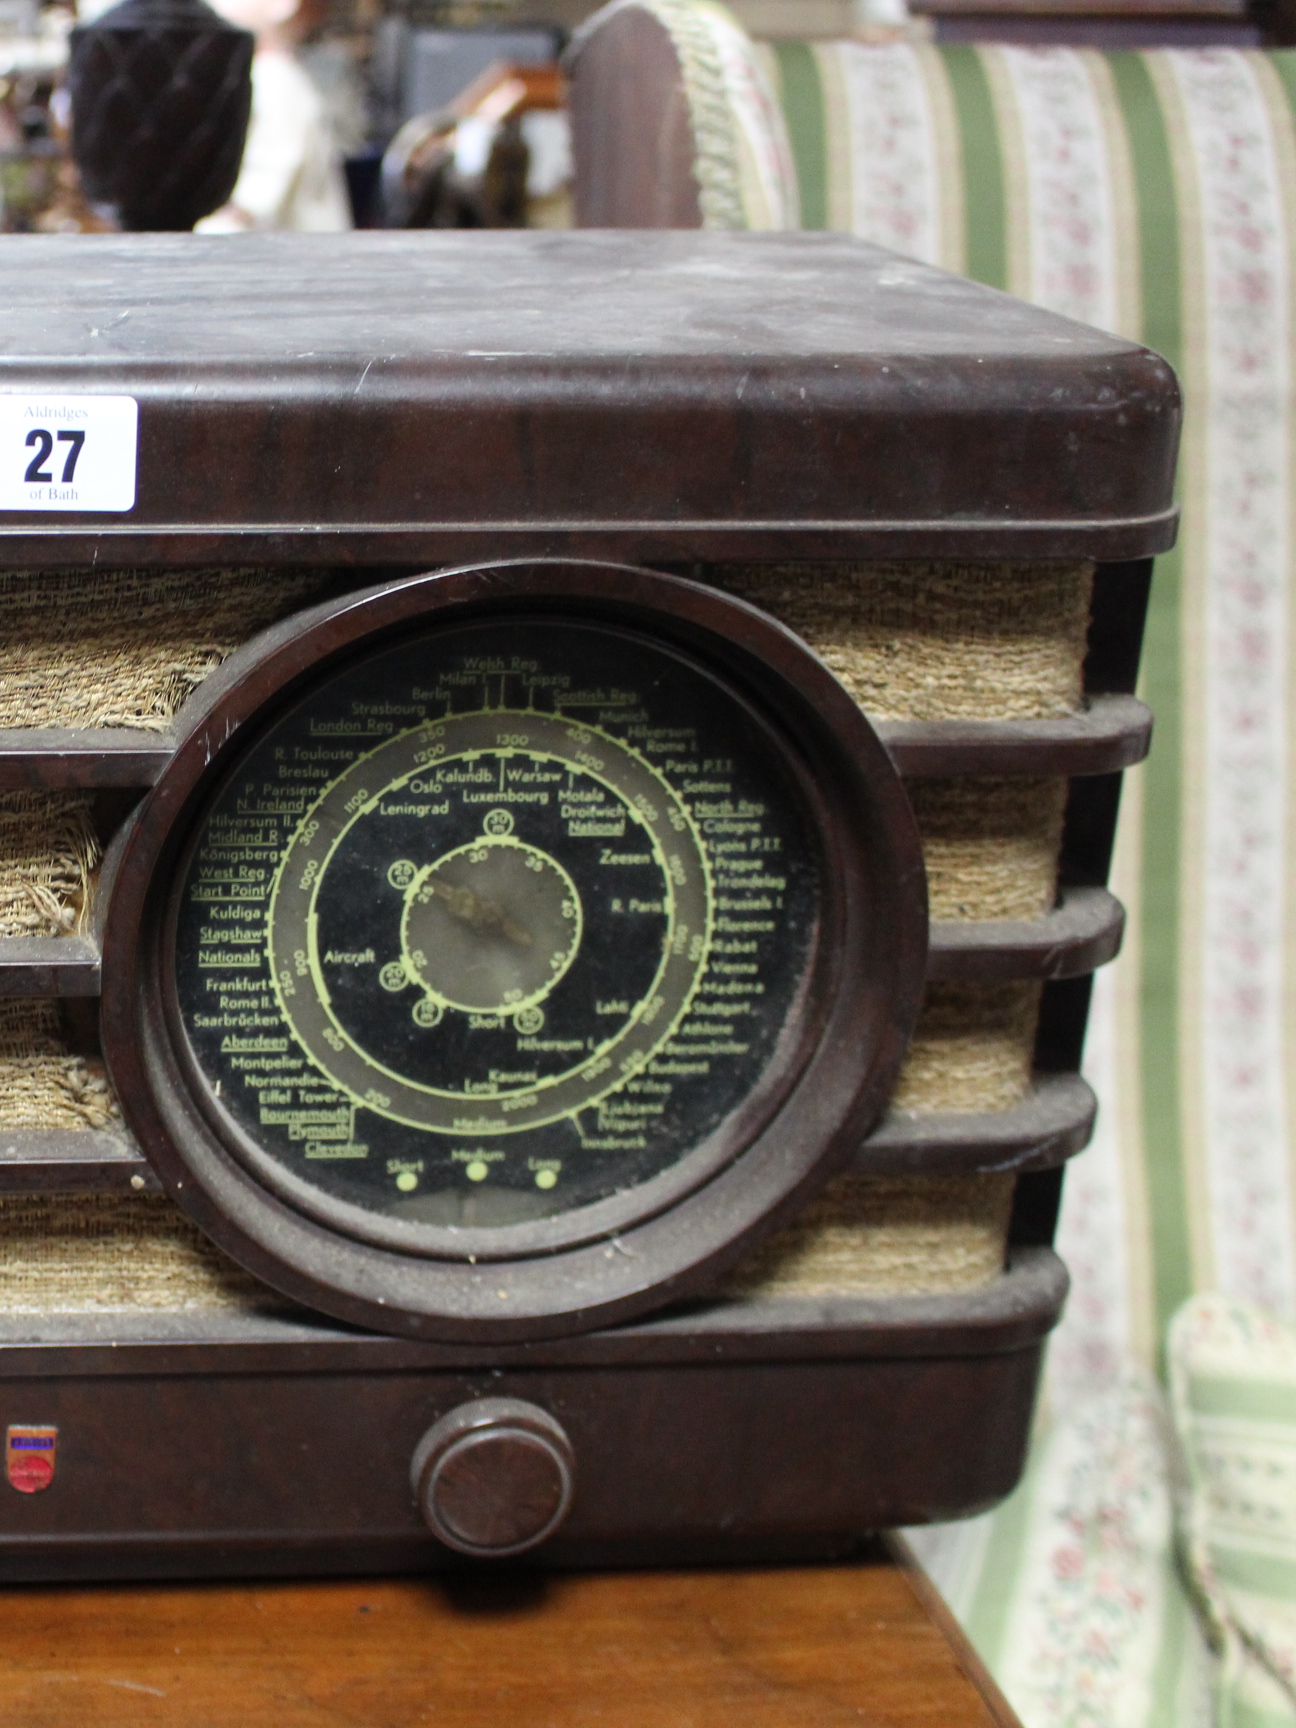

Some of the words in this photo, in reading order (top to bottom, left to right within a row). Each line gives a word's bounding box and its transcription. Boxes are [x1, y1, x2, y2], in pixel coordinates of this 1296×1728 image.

[24, 406, 88, 421] Aldridges
[24, 429, 85, 483] 27
[30, 488, 44, 500] of
[48, 488, 78, 500] Bath
[464, 656, 504, 669] Welsh
[439, 673, 476, 686] Milan
[522, 673, 571, 689] Leipzig
[412, 687, 451, 700] Berlin
[352, 701, 426, 717] Strasbourg
[310, 718, 361, 732] London
[418, 726, 446, 743] 350
[496, 733, 529, 746] 1300
[565, 727, 592, 744] 400
[275, 748, 287, 760] R.
[294, 747, 353, 760] Toulouse
[413, 743, 446, 764] 1200
[575, 750, 604, 771] 1400
[279, 765, 329, 778] Breslau
[665, 759, 699, 773] Paris
[507, 769, 563, 783] Warsaw
[263, 783, 316, 797] Parisien
[410, 779, 443, 794] Oslo
[344, 788, 369, 814] 1100
[462, 790, 550, 806] Luxembourg
[557, 788, 605, 803] Motala
[257, 798, 303, 811] Ireland
[379, 800, 450, 818] Leningrad
[561, 804, 626, 819] Droitwich
[695, 801, 733, 815] North
[209, 815, 277, 828] Hilversum
[490, 814, 507, 825] 30
[703, 819, 762, 834] Cologne
[299, 820, 320, 847] 300
[492, 825, 505, 834] m
[568, 820, 624, 836] National
[209, 830, 262, 844] Midland
[468, 850, 489, 864] 30
[524, 855, 545, 873] 35
[199, 866, 234, 879] West
[298, 860, 319, 891] 1000
[190, 884, 222, 898] Start
[230, 884, 265, 898] Point
[209, 905, 261, 922] Kuldiga
[561, 899, 575, 919] 40
[199, 926, 263, 942] Stagshaw
[198, 950, 260, 965] Nationals
[294, 950, 308, 977] 900
[324, 949, 375, 964] Aircraft
[412, 950, 428, 969] 20
[549, 951, 566, 971] 45
[206, 977, 267, 992] Frankfurt
[279, 971, 296, 997] 250
[219, 996, 257, 1009] Rome
[193, 1014, 279, 1029] Saarbrücken
[469, 1014, 504, 1029] Short
[222, 1034, 288, 1049] Aberdeen
[322, 1026, 345, 1052] 800
[517, 1037, 584, 1051] Hilversum
[231, 1057, 303, 1072] Montpelier
[245, 1074, 320, 1088] Normandie
[464, 1077, 498, 1095] Long
[258, 1090, 292, 1105] Eiffel
[299, 1091, 339, 1104] Tower
[260, 1106, 350, 1122] Bournemouth
[288, 1123, 349, 1139] Plymouth
[386, 1159, 425, 1174] Short
[527, 1156, 562, 1173] Long
